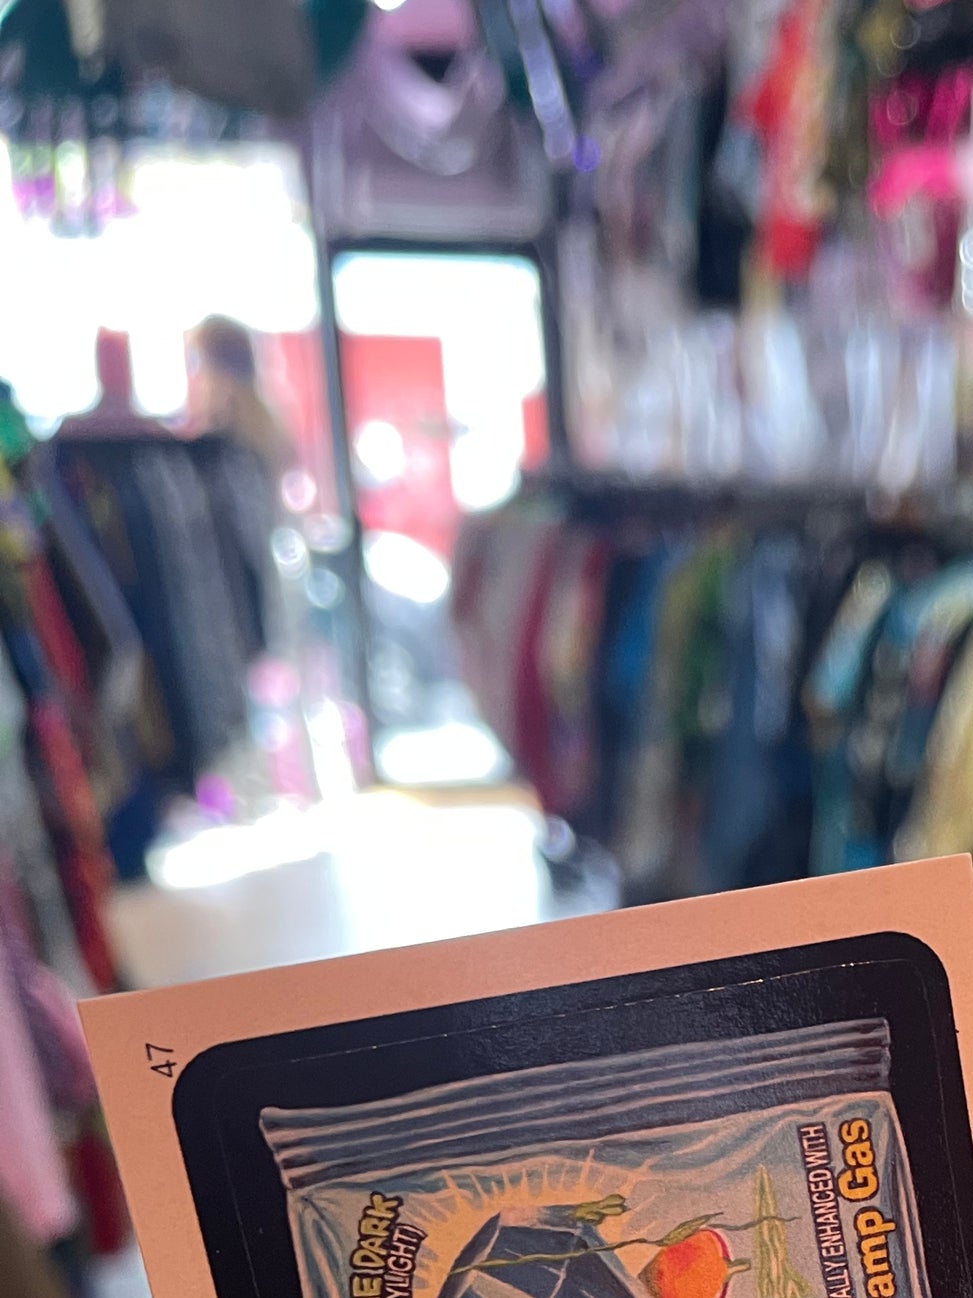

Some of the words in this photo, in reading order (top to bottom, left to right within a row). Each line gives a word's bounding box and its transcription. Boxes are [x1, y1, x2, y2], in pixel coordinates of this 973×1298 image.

[145, 1043, 177, 1078] 47
[800, 1125, 830, 1166] WITH
[838, 1118, 878, 1200] Gas
[351, 1192, 401, 1268] DARK
[809, 1168, 845, 1258] ENHANCED
